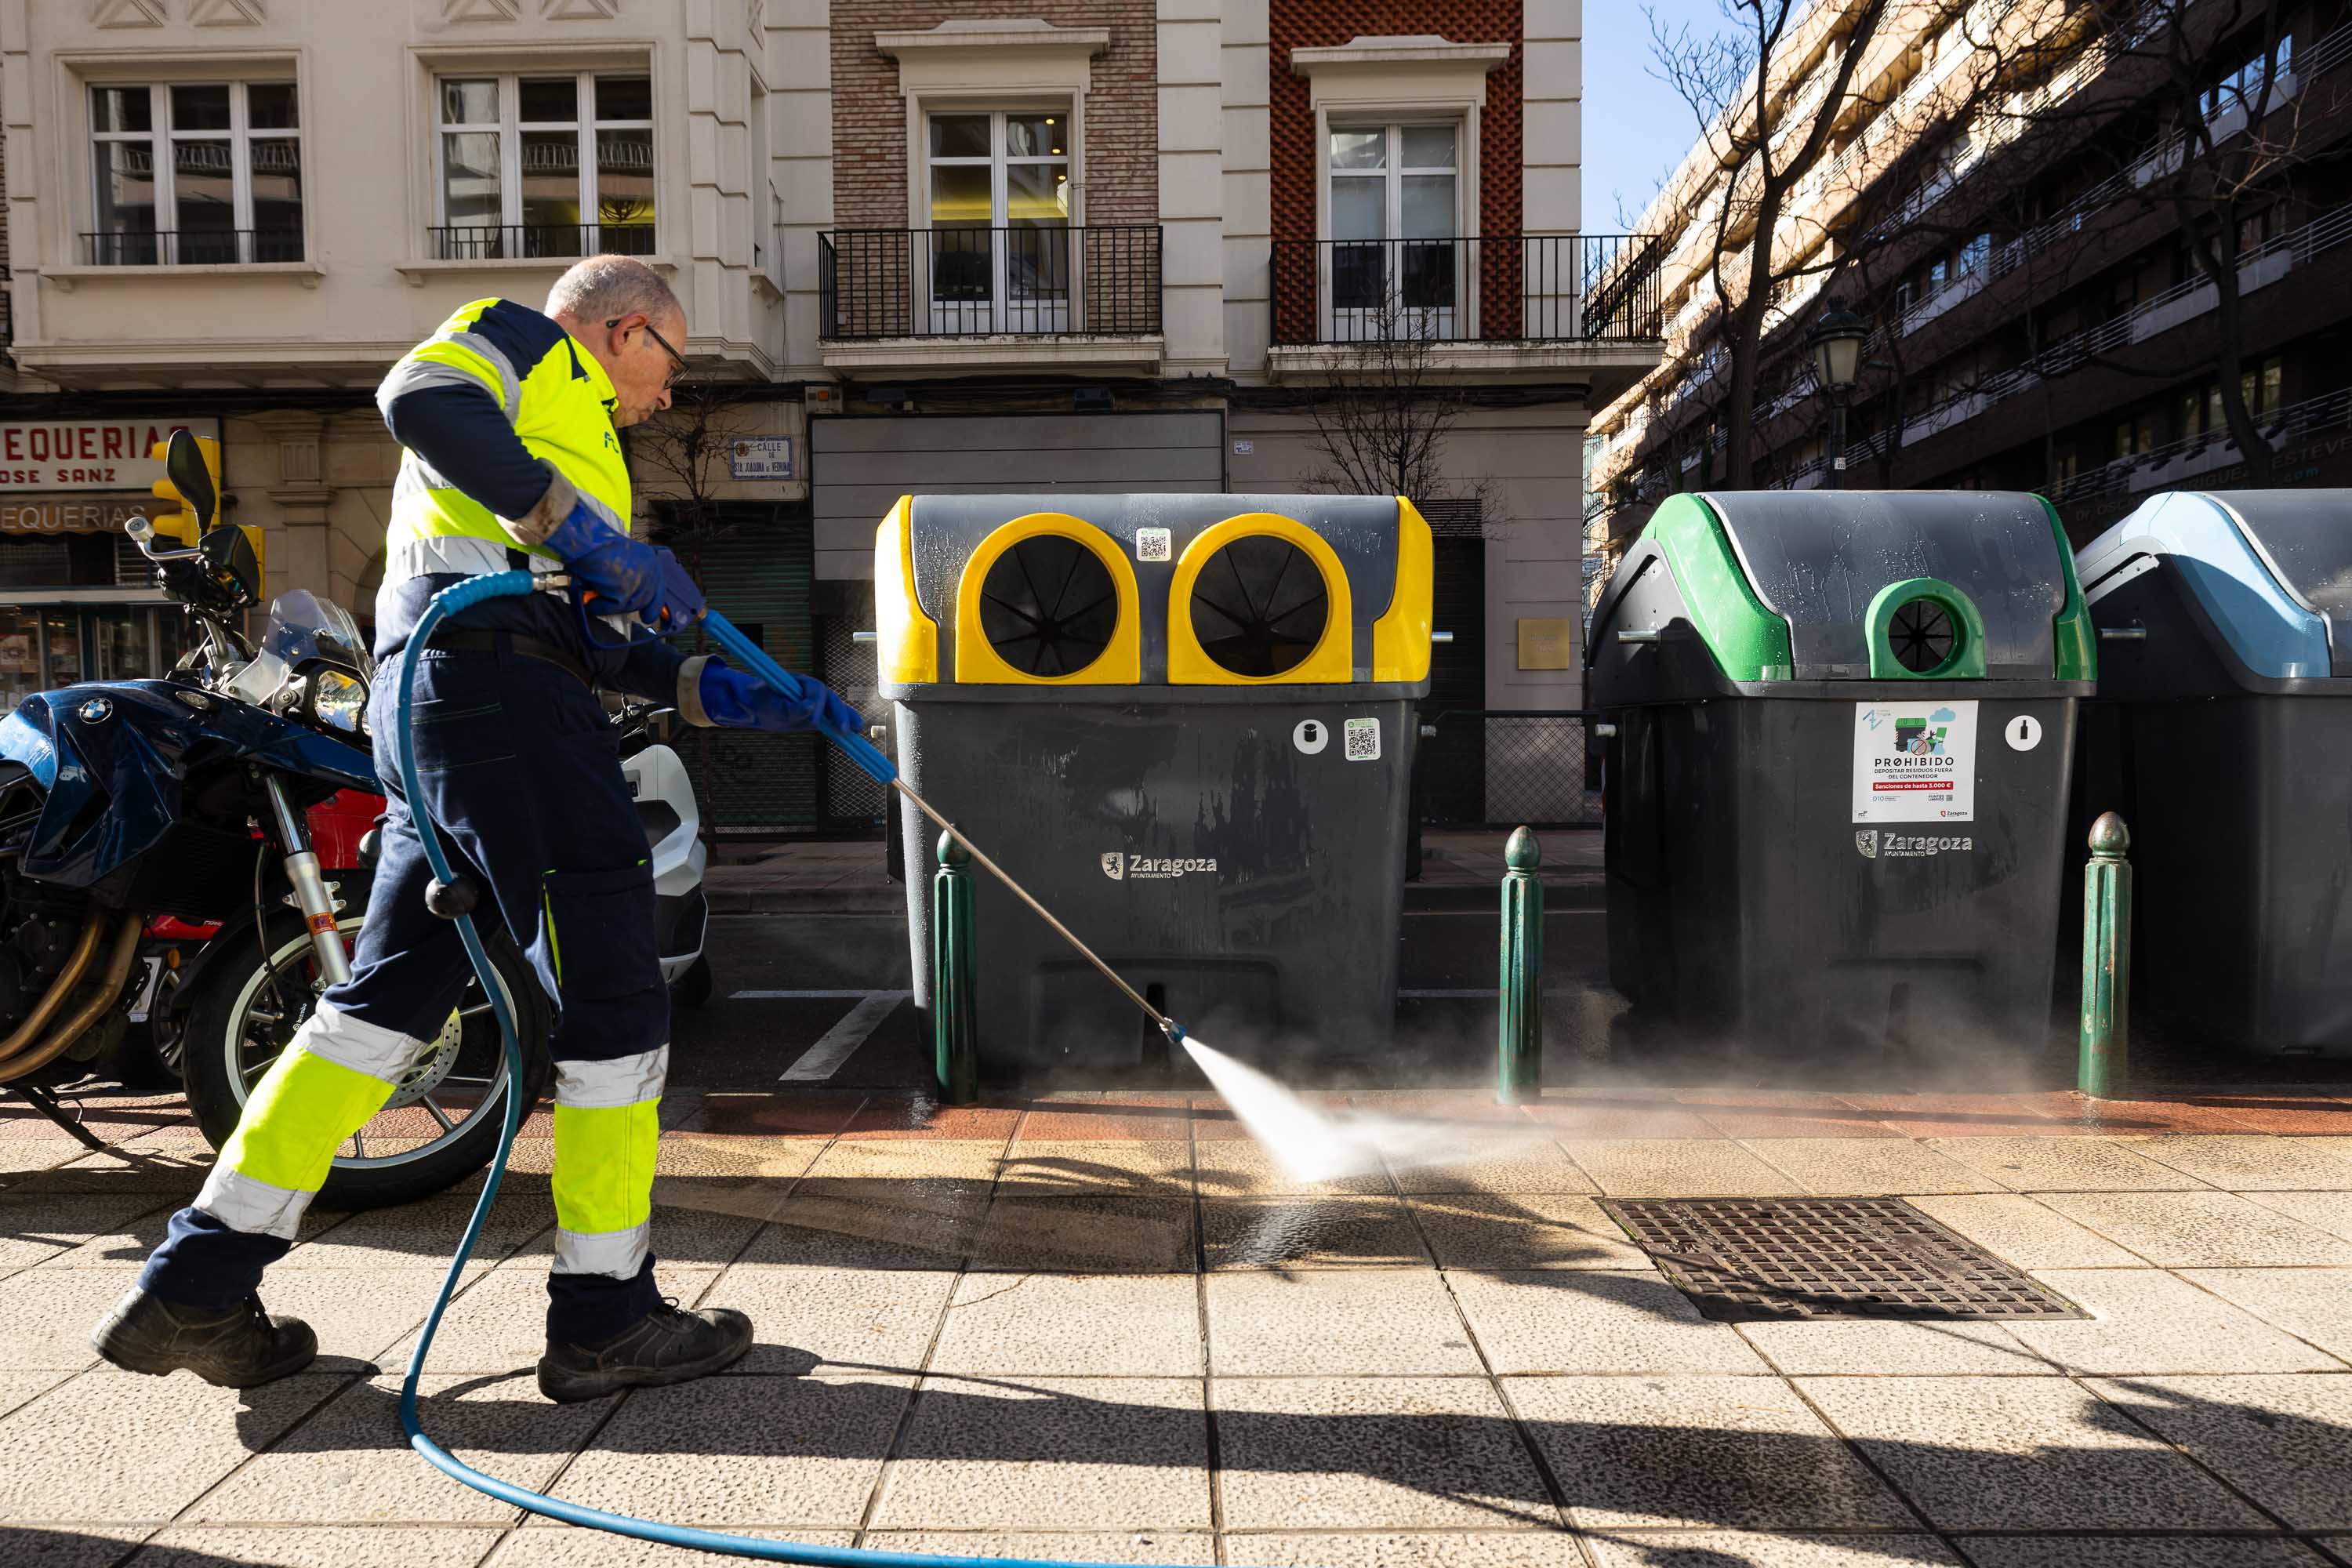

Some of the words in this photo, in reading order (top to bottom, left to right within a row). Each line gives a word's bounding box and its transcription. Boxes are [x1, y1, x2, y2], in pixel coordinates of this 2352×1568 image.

[4, 426, 189, 462] EQUERIA
[757, 442, 781, 452] CALLE
[57, 469, 115, 483] SANZ
[1883, 833, 1973, 855] Zaragoza
[1129, 855, 1218, 877] Zaragoza
